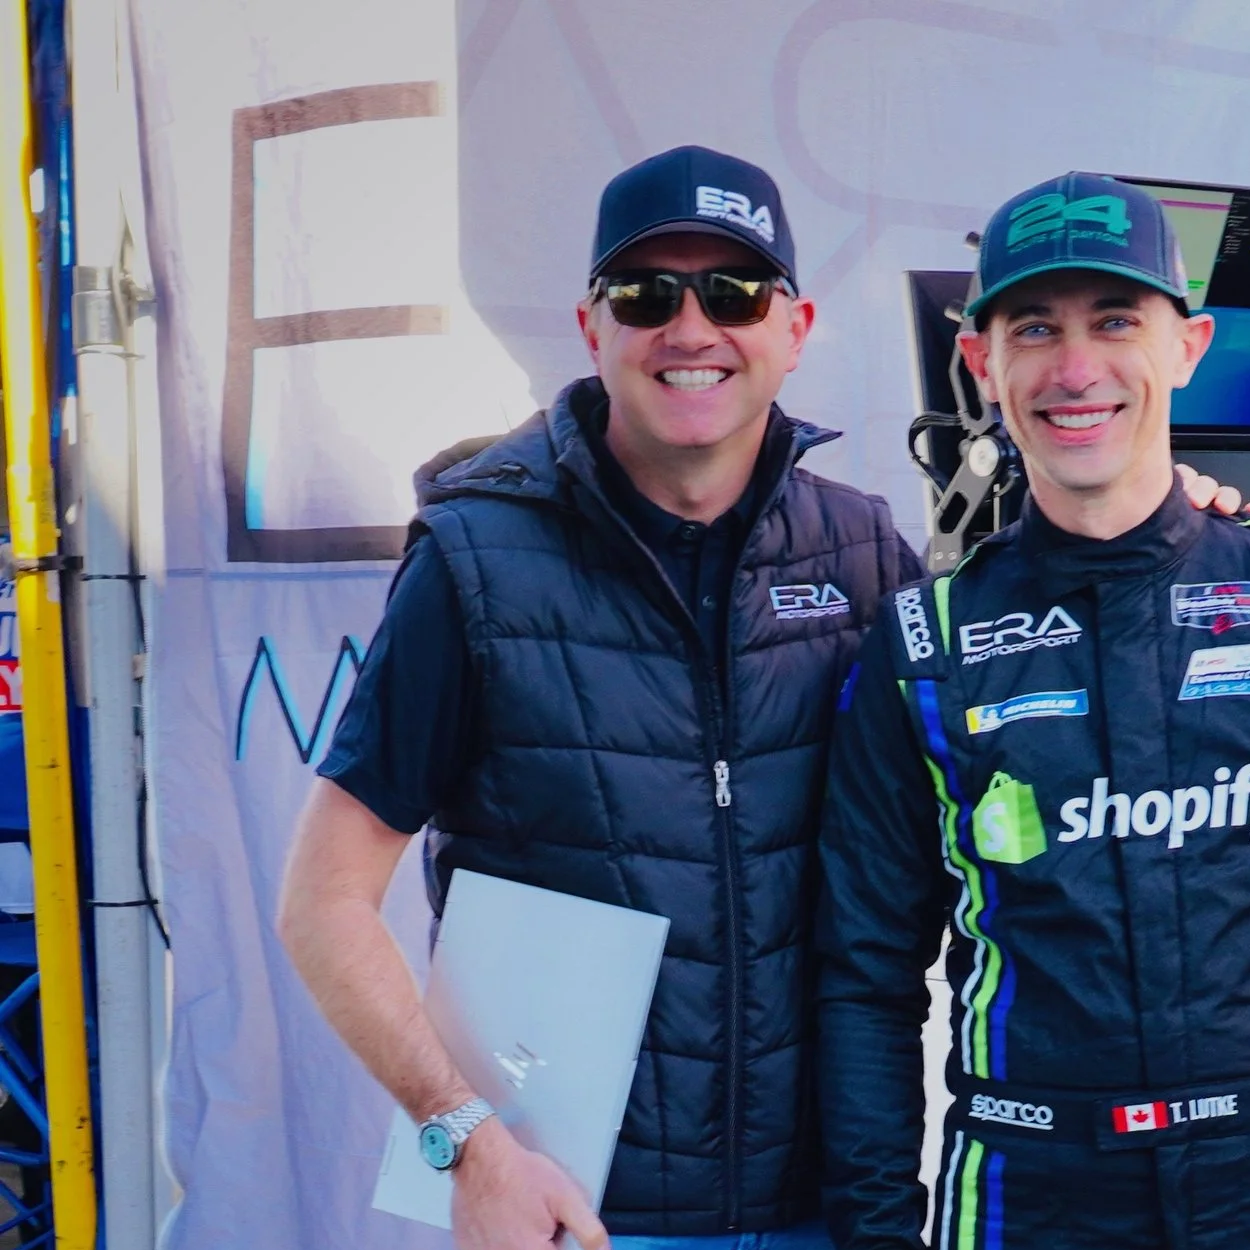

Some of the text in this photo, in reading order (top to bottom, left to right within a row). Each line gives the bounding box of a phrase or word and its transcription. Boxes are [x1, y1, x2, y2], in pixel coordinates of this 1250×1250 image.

[695, 185, 775, 236] ERA
[1007, 193, 1132, 247] 24
[769, 583, 849, 611] ERA
[894, 587, 935, 663] sparco
[959, 605, 1083, 654] ERA
[961, 633, 1082, 665] MOTORSPORT
[969, 1094, 1054, 1130] sparco
